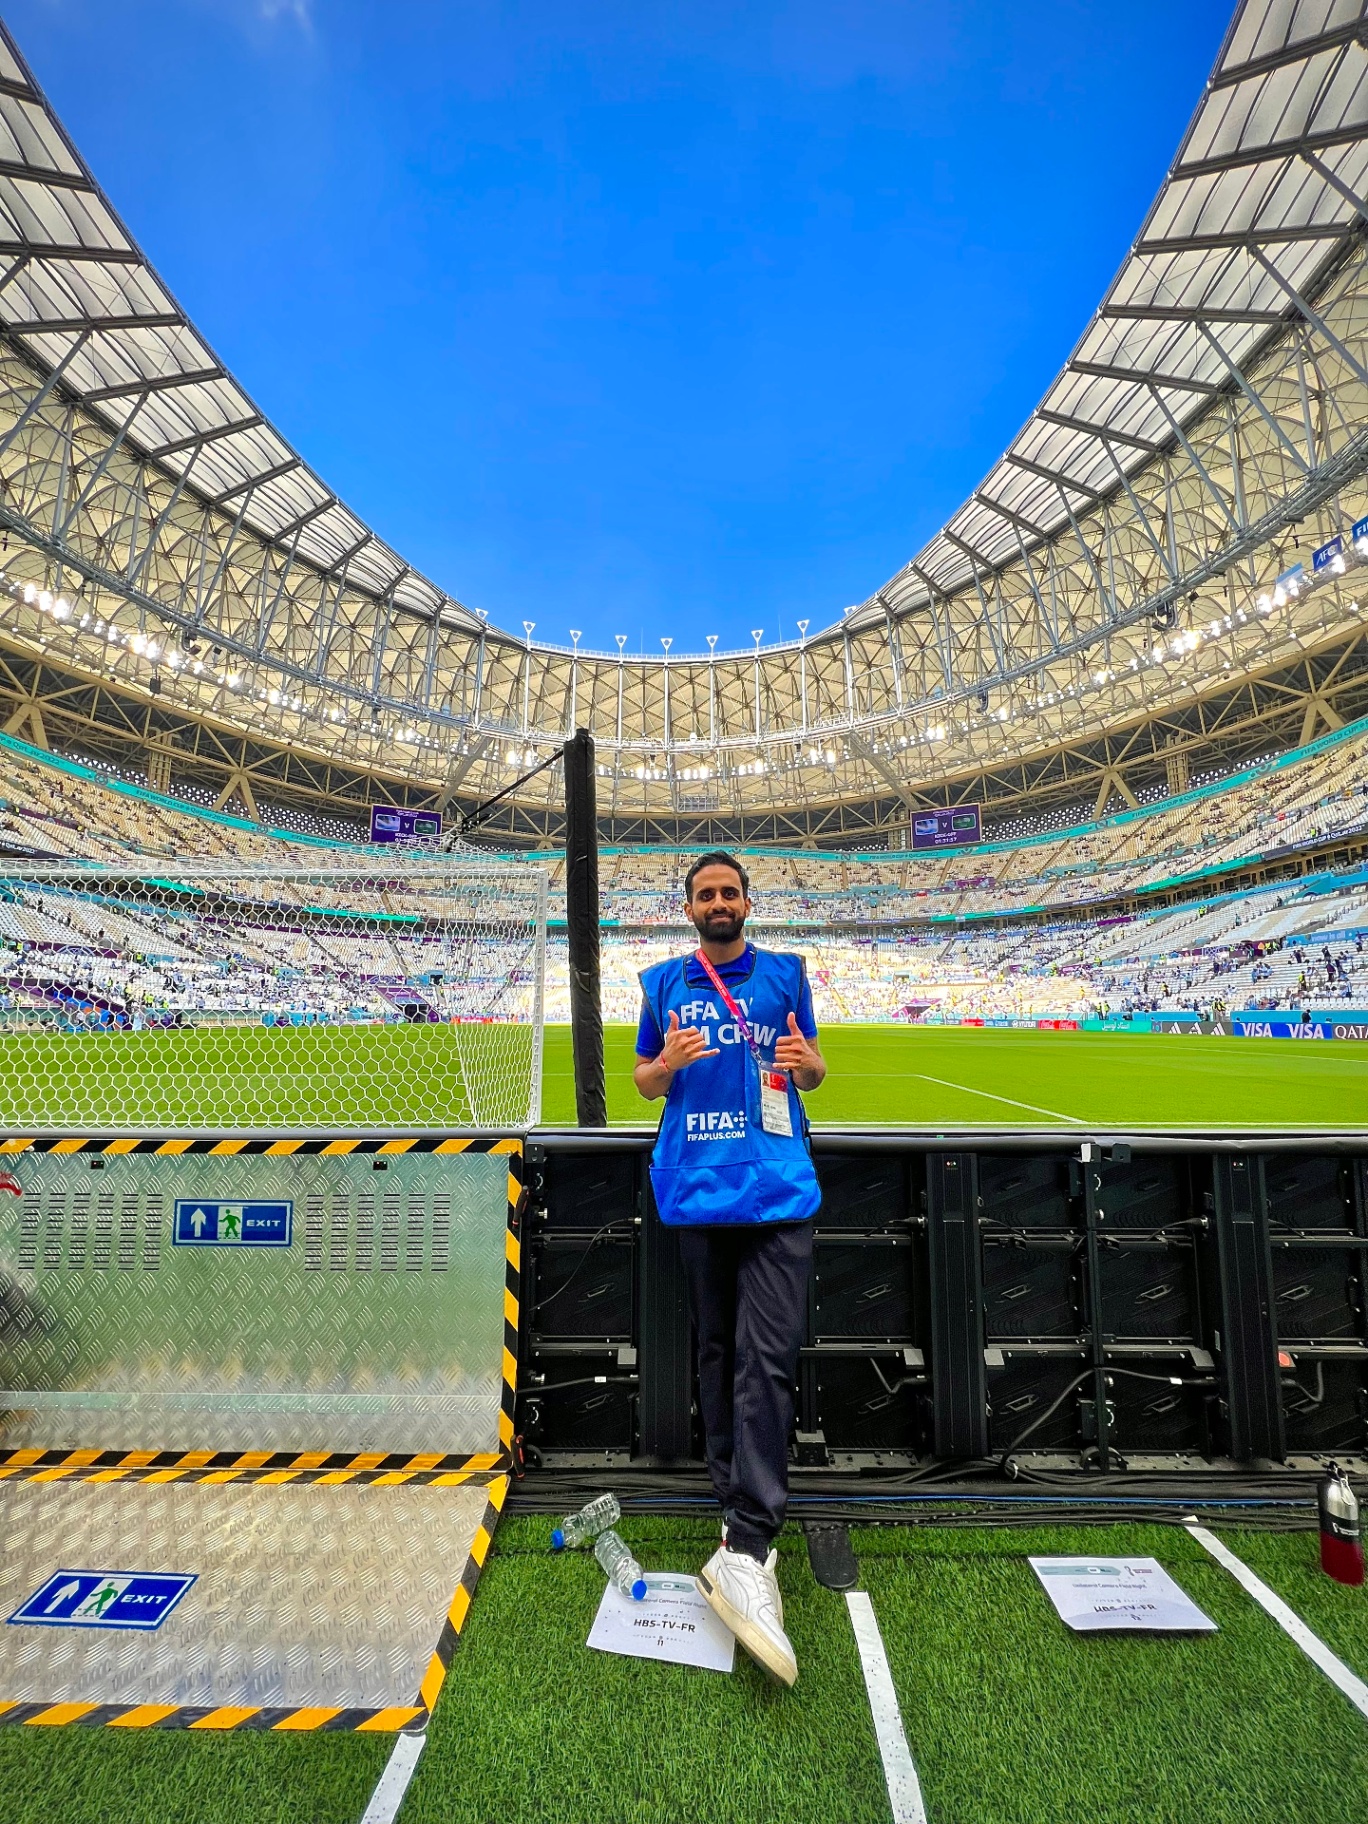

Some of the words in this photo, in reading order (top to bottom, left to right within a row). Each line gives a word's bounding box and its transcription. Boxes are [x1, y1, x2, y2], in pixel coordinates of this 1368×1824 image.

[1356, 522, 1368, 536] FI
[1317, 734, 1343, 749] WORLD
[1344, 725, 1358, 736] CUP
[1240, 1022, 1273, 1037] VISA
[1286, 1023, 1325, 1039] VISA
[686, 1111, 734, 1131] FIFA
[687, 1130, 746, 1142] FIFAPLUS.COM
[246, 1219, 281, 1227] EXIT
[120, 1594, 168, 1605] EXIT
[633, 1618, 697, 1633] HBS-TV-FR
